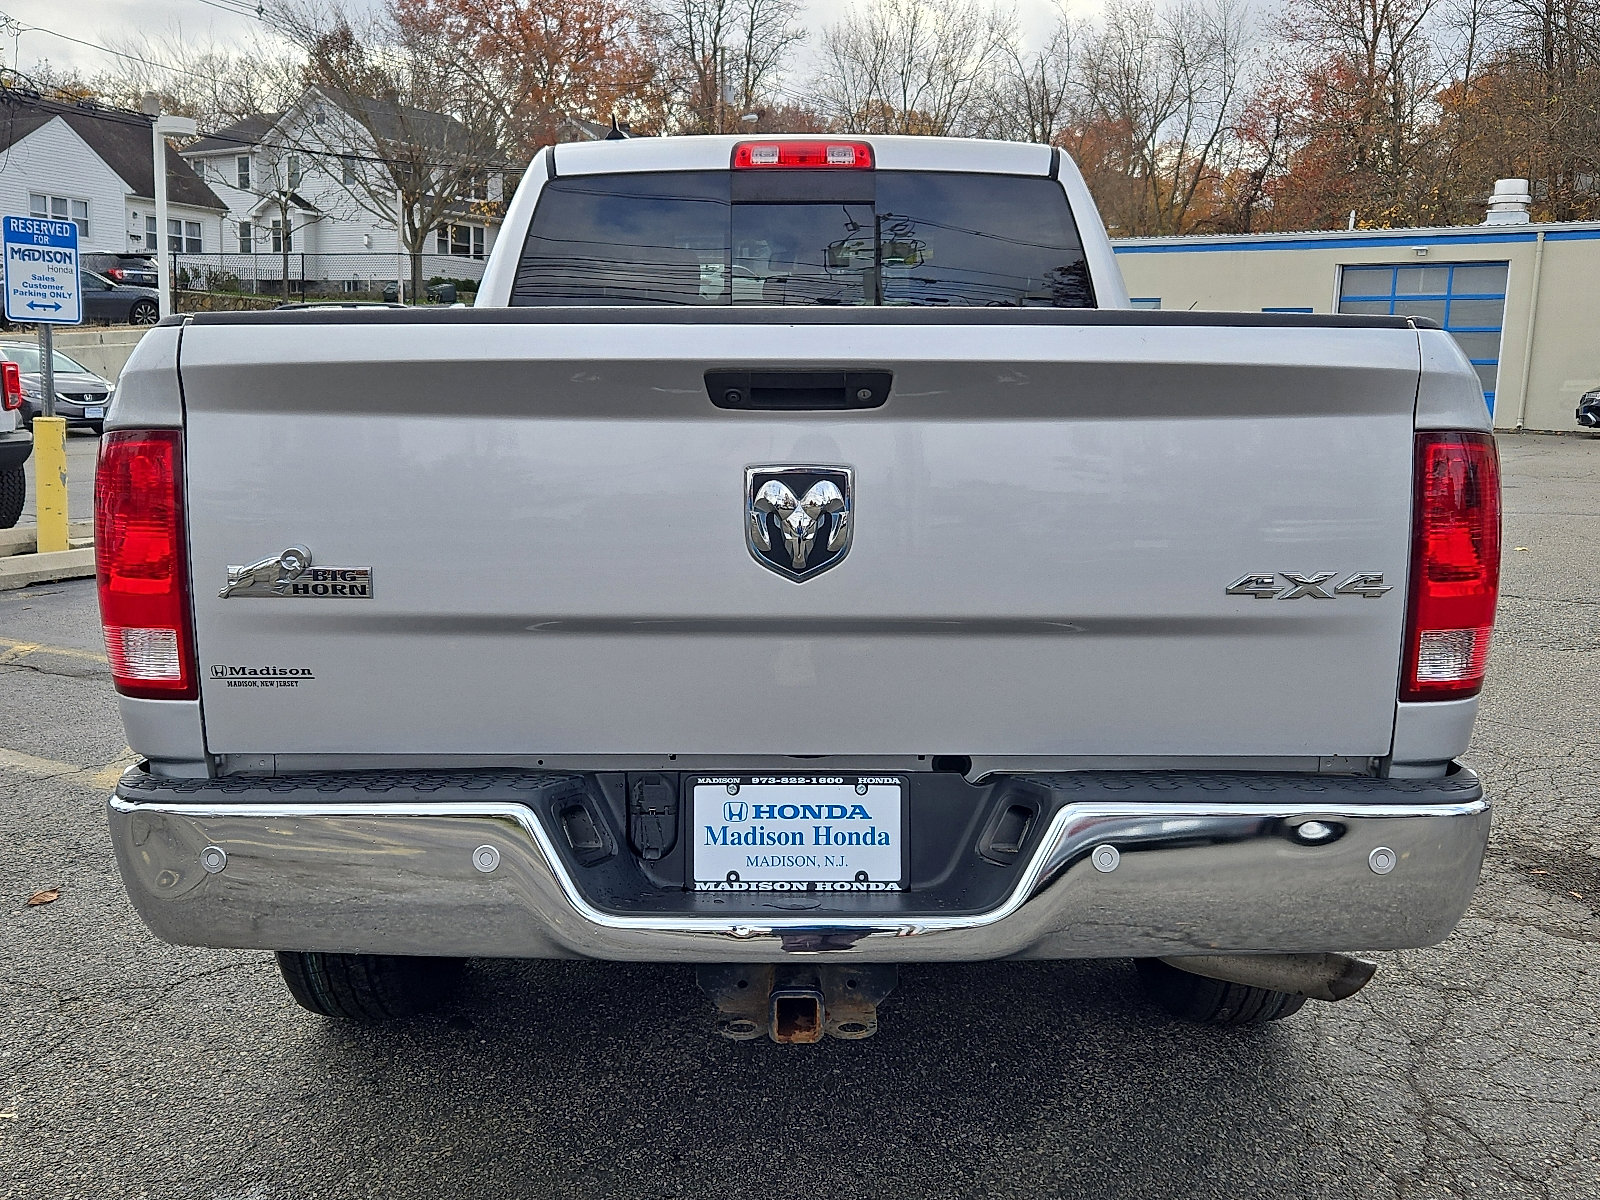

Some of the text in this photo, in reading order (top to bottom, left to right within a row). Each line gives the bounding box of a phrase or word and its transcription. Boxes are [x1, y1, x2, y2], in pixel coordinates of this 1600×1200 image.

[10, 219, 70, 237] RESERVED
[33, 236, 49, 244] FOR
[10, 247, 73, 265] MADISON
[47, 265, 73, 274] Honda
[31, 274, 55, 282] Sales
[22, 282, 64, 291] Customer
[13, 289, 73, 299] Parking ONLY
[312, 569, 357, 582] BIG
[292, 584, 367, 595] HORN
[1225, 571, 1394, 600] 4X4
[228, 666, 313, 676] Madison
[227, 680, 259, 688] MADISON,
[276, 680, 299, 688] JERSEY
[752, 804, 872, 820] HONDA
[704, 825, 890, 846] Madison Honda
[745, 855, 849, 868] MADISON, N.J.
[694, 882, 902, 891] MADISON HONDA
